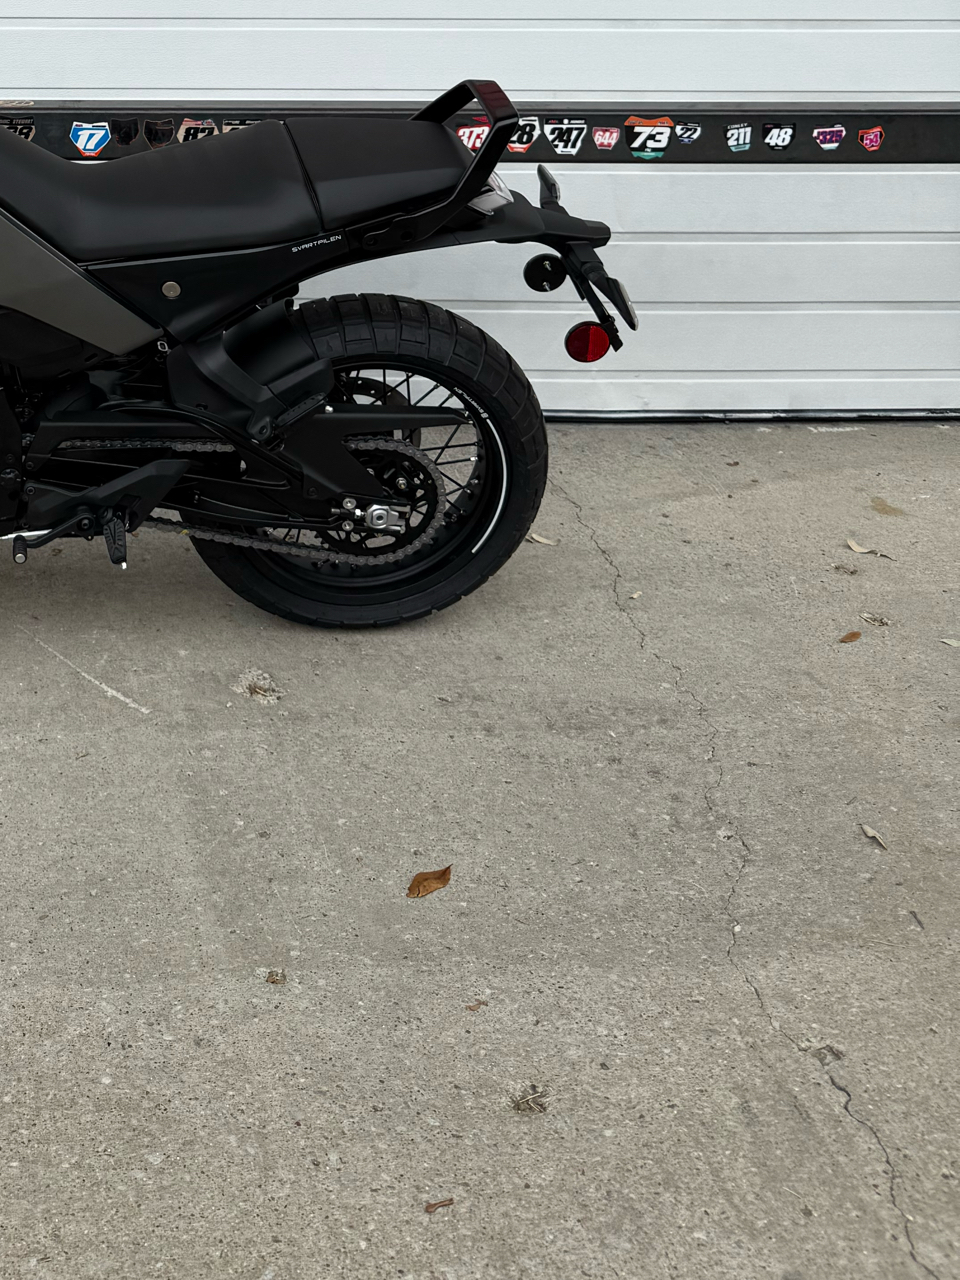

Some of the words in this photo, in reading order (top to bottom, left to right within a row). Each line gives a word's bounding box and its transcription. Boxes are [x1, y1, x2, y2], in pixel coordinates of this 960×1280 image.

[77, 130, 107, 150] 17
[549, 127, 585, 149] 247
[595, 131, 618, 146] 644
[630, 126, 671, 148] 73
[726, 127, 752, 147] 211
[764, 128, 793, 146] 48
[864, 132, 880, 148] 54
[291, 235, 342, 253] SVARTPILEN
